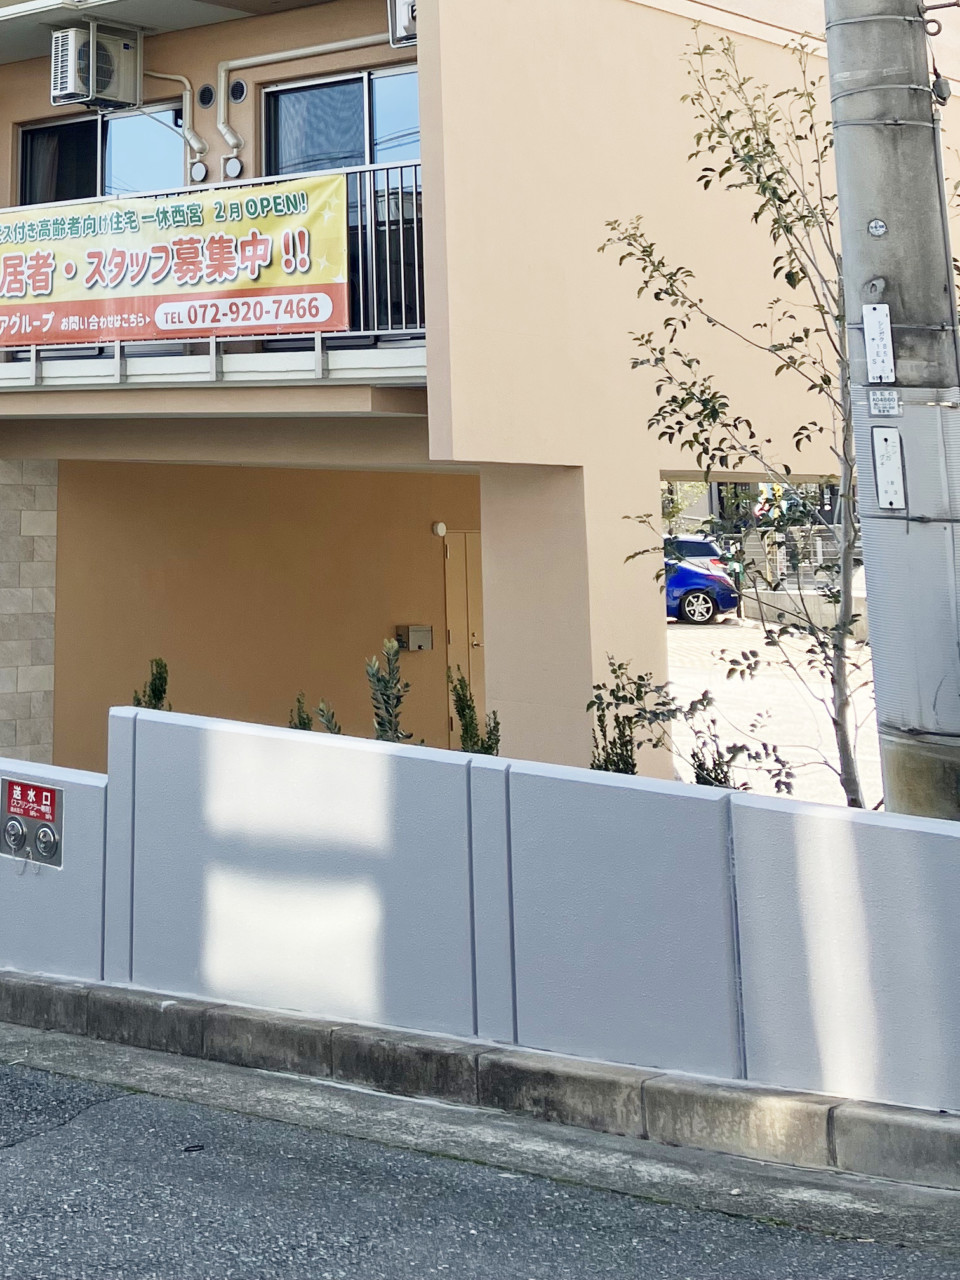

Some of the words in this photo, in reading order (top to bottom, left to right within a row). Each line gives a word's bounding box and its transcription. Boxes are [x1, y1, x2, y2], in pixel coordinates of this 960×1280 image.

[141, 202, 203, 227] 一休西宮
[245, 193, 307, 218] OPEN!
[60, 313, 145, 331] お問い合わせはこちら
[164, 312, 184, 325] TEL
[188, 297, 320, 325] 072-920-7466
[12, 784, 51, 806] 送水口
